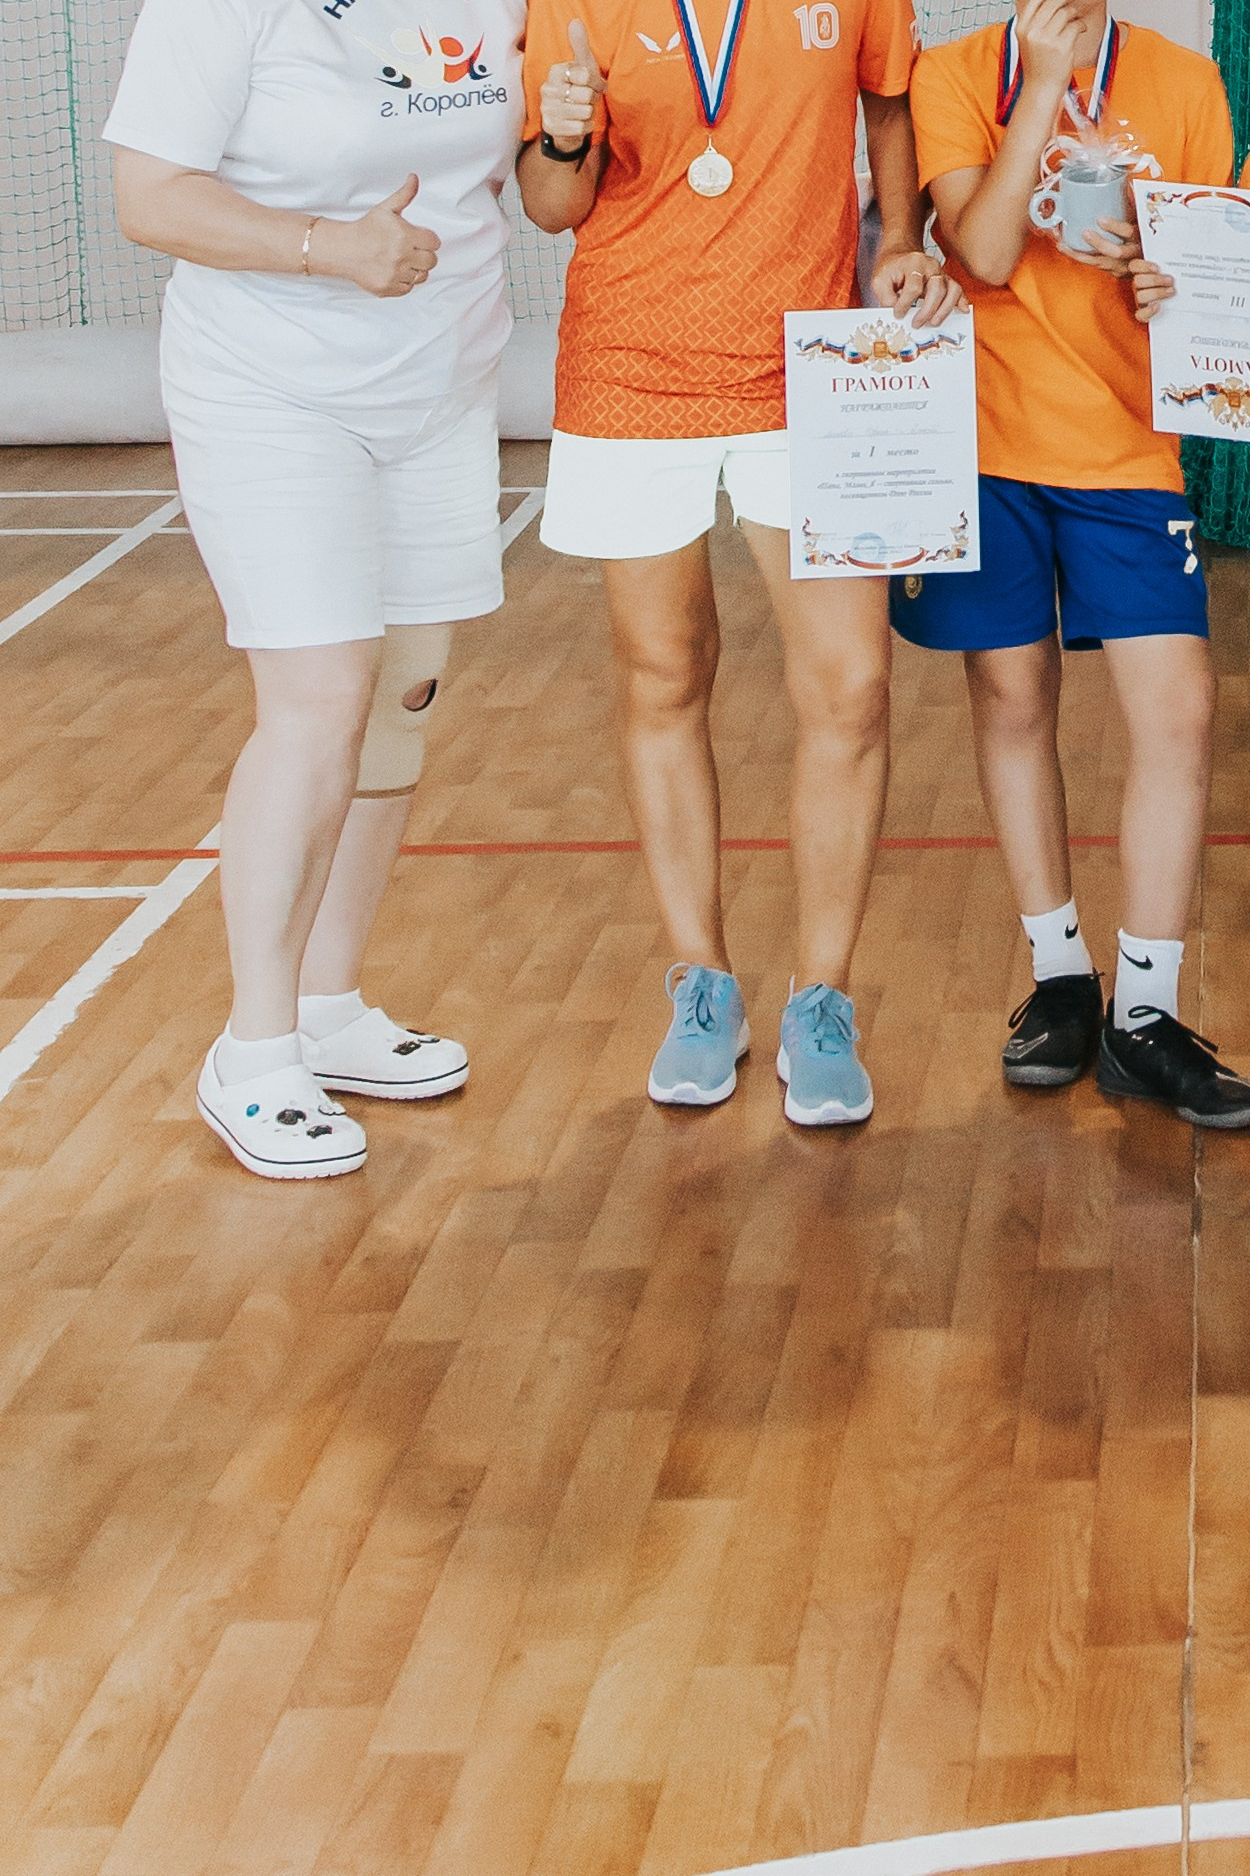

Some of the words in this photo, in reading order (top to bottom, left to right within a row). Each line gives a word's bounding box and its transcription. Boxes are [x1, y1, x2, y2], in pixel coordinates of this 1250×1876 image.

[792, 2, 839, 50] 10
[380, 101, 399, 117] г.
[408, 84, 508, 116] Королёв
[832, 375, 931, 393] ГРАМОТА
